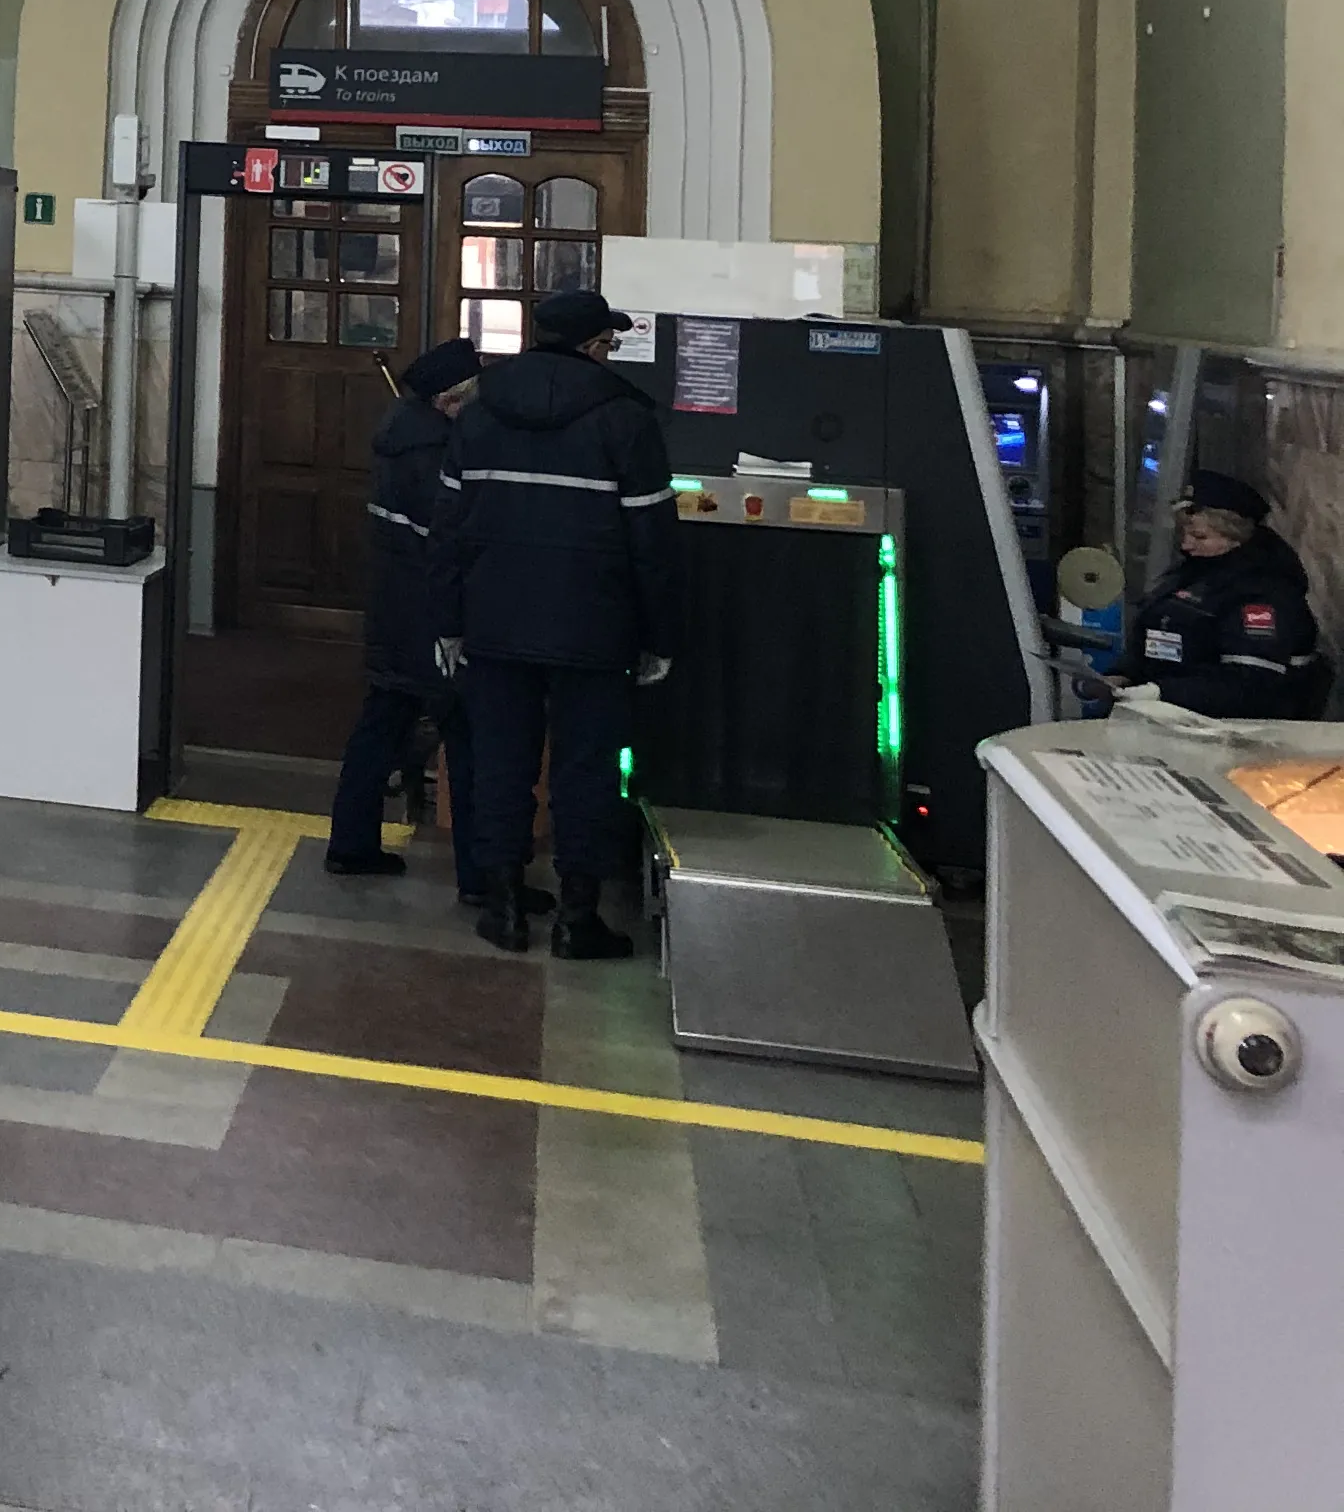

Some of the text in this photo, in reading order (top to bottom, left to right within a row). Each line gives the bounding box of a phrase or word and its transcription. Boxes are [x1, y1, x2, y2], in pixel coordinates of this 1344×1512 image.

[334, 65, 439, 85] К поездам
[336, 88, 396, 102] To trains
[402, 137, 457, 150] ВЫХОД
